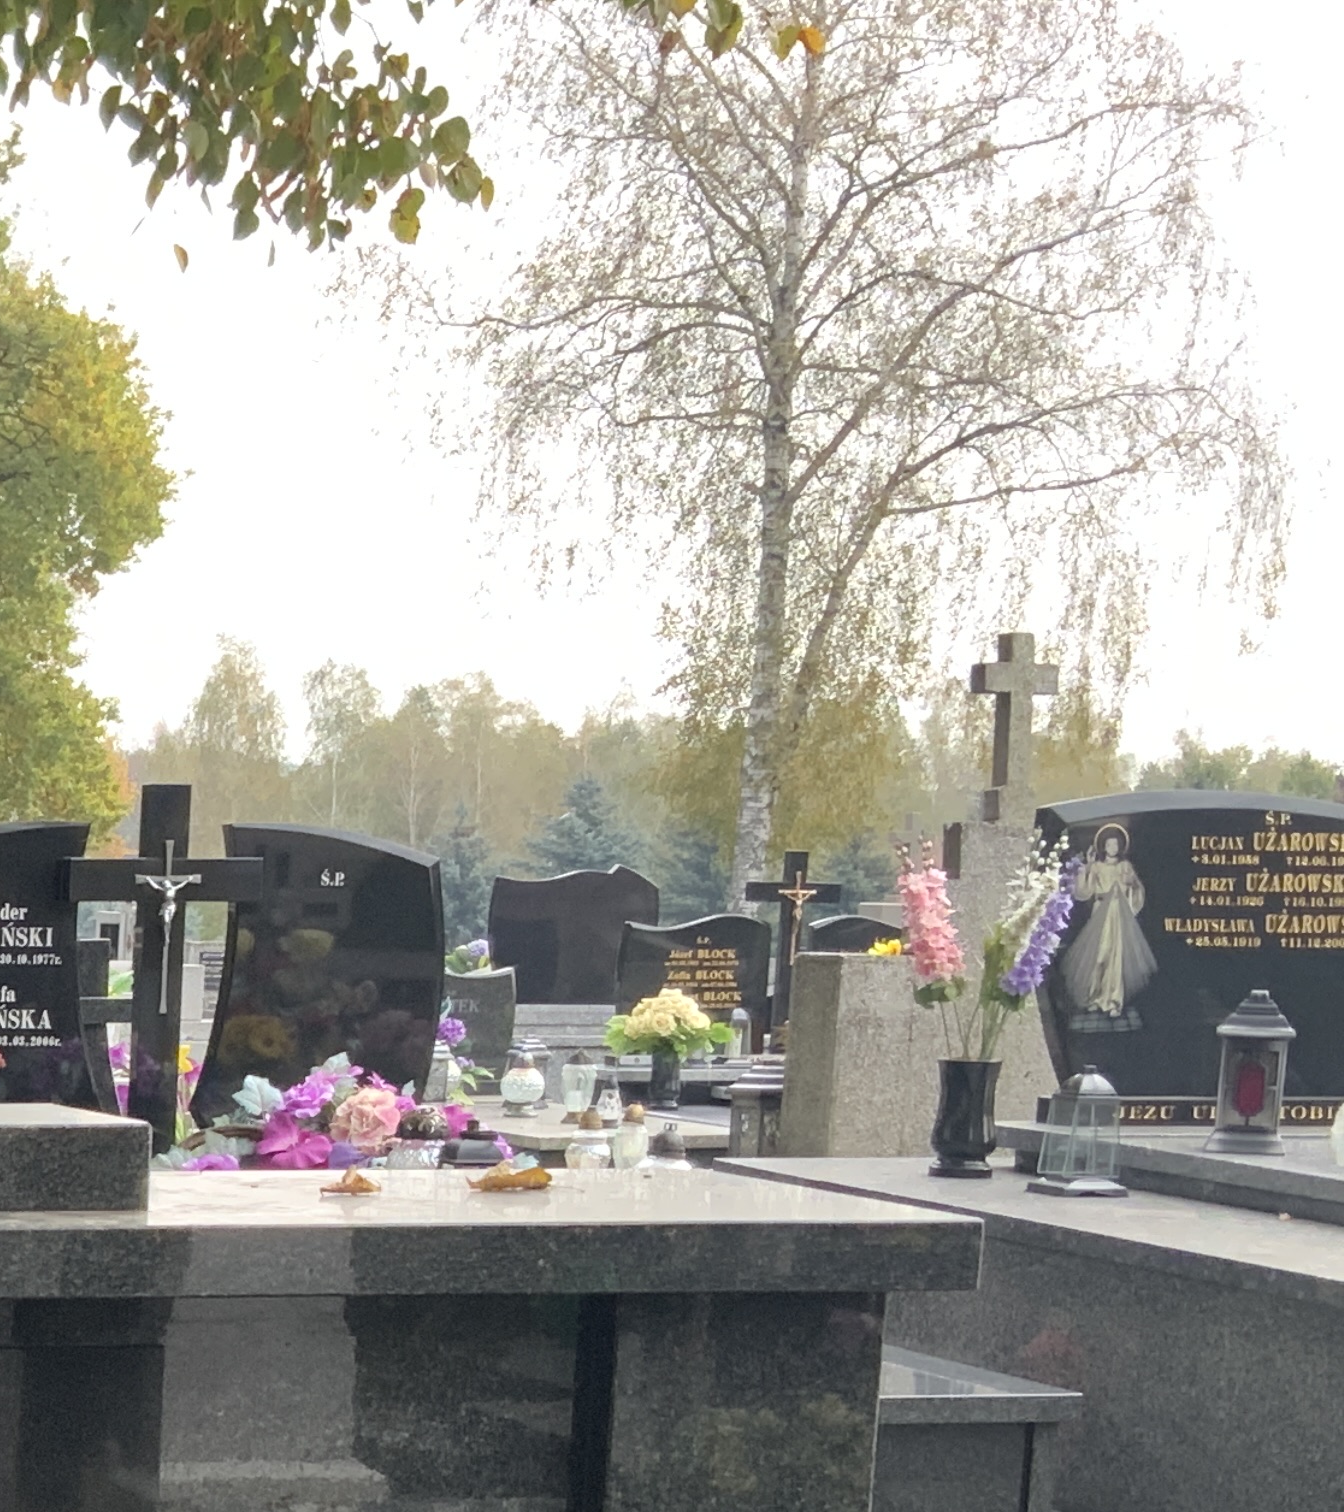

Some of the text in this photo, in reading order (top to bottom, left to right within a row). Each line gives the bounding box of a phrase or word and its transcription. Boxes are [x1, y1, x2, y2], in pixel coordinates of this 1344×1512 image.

[1253, 827, 1344, 852] UŻAROWS
[1192, 867, 1344, 893] JERZY UŻAROWSK
[1164, 917, 1255, 933] WŁADYSŁAWA
[697, 949, 736, 959] BLOCK
[695, 970, 734, 980] BLOCK
[703, 991, 742, 1001] BLOCK
[1118, 1105, 1175, 1120] JEZU
[1279, 1105, 1334, 1120] TOBI
